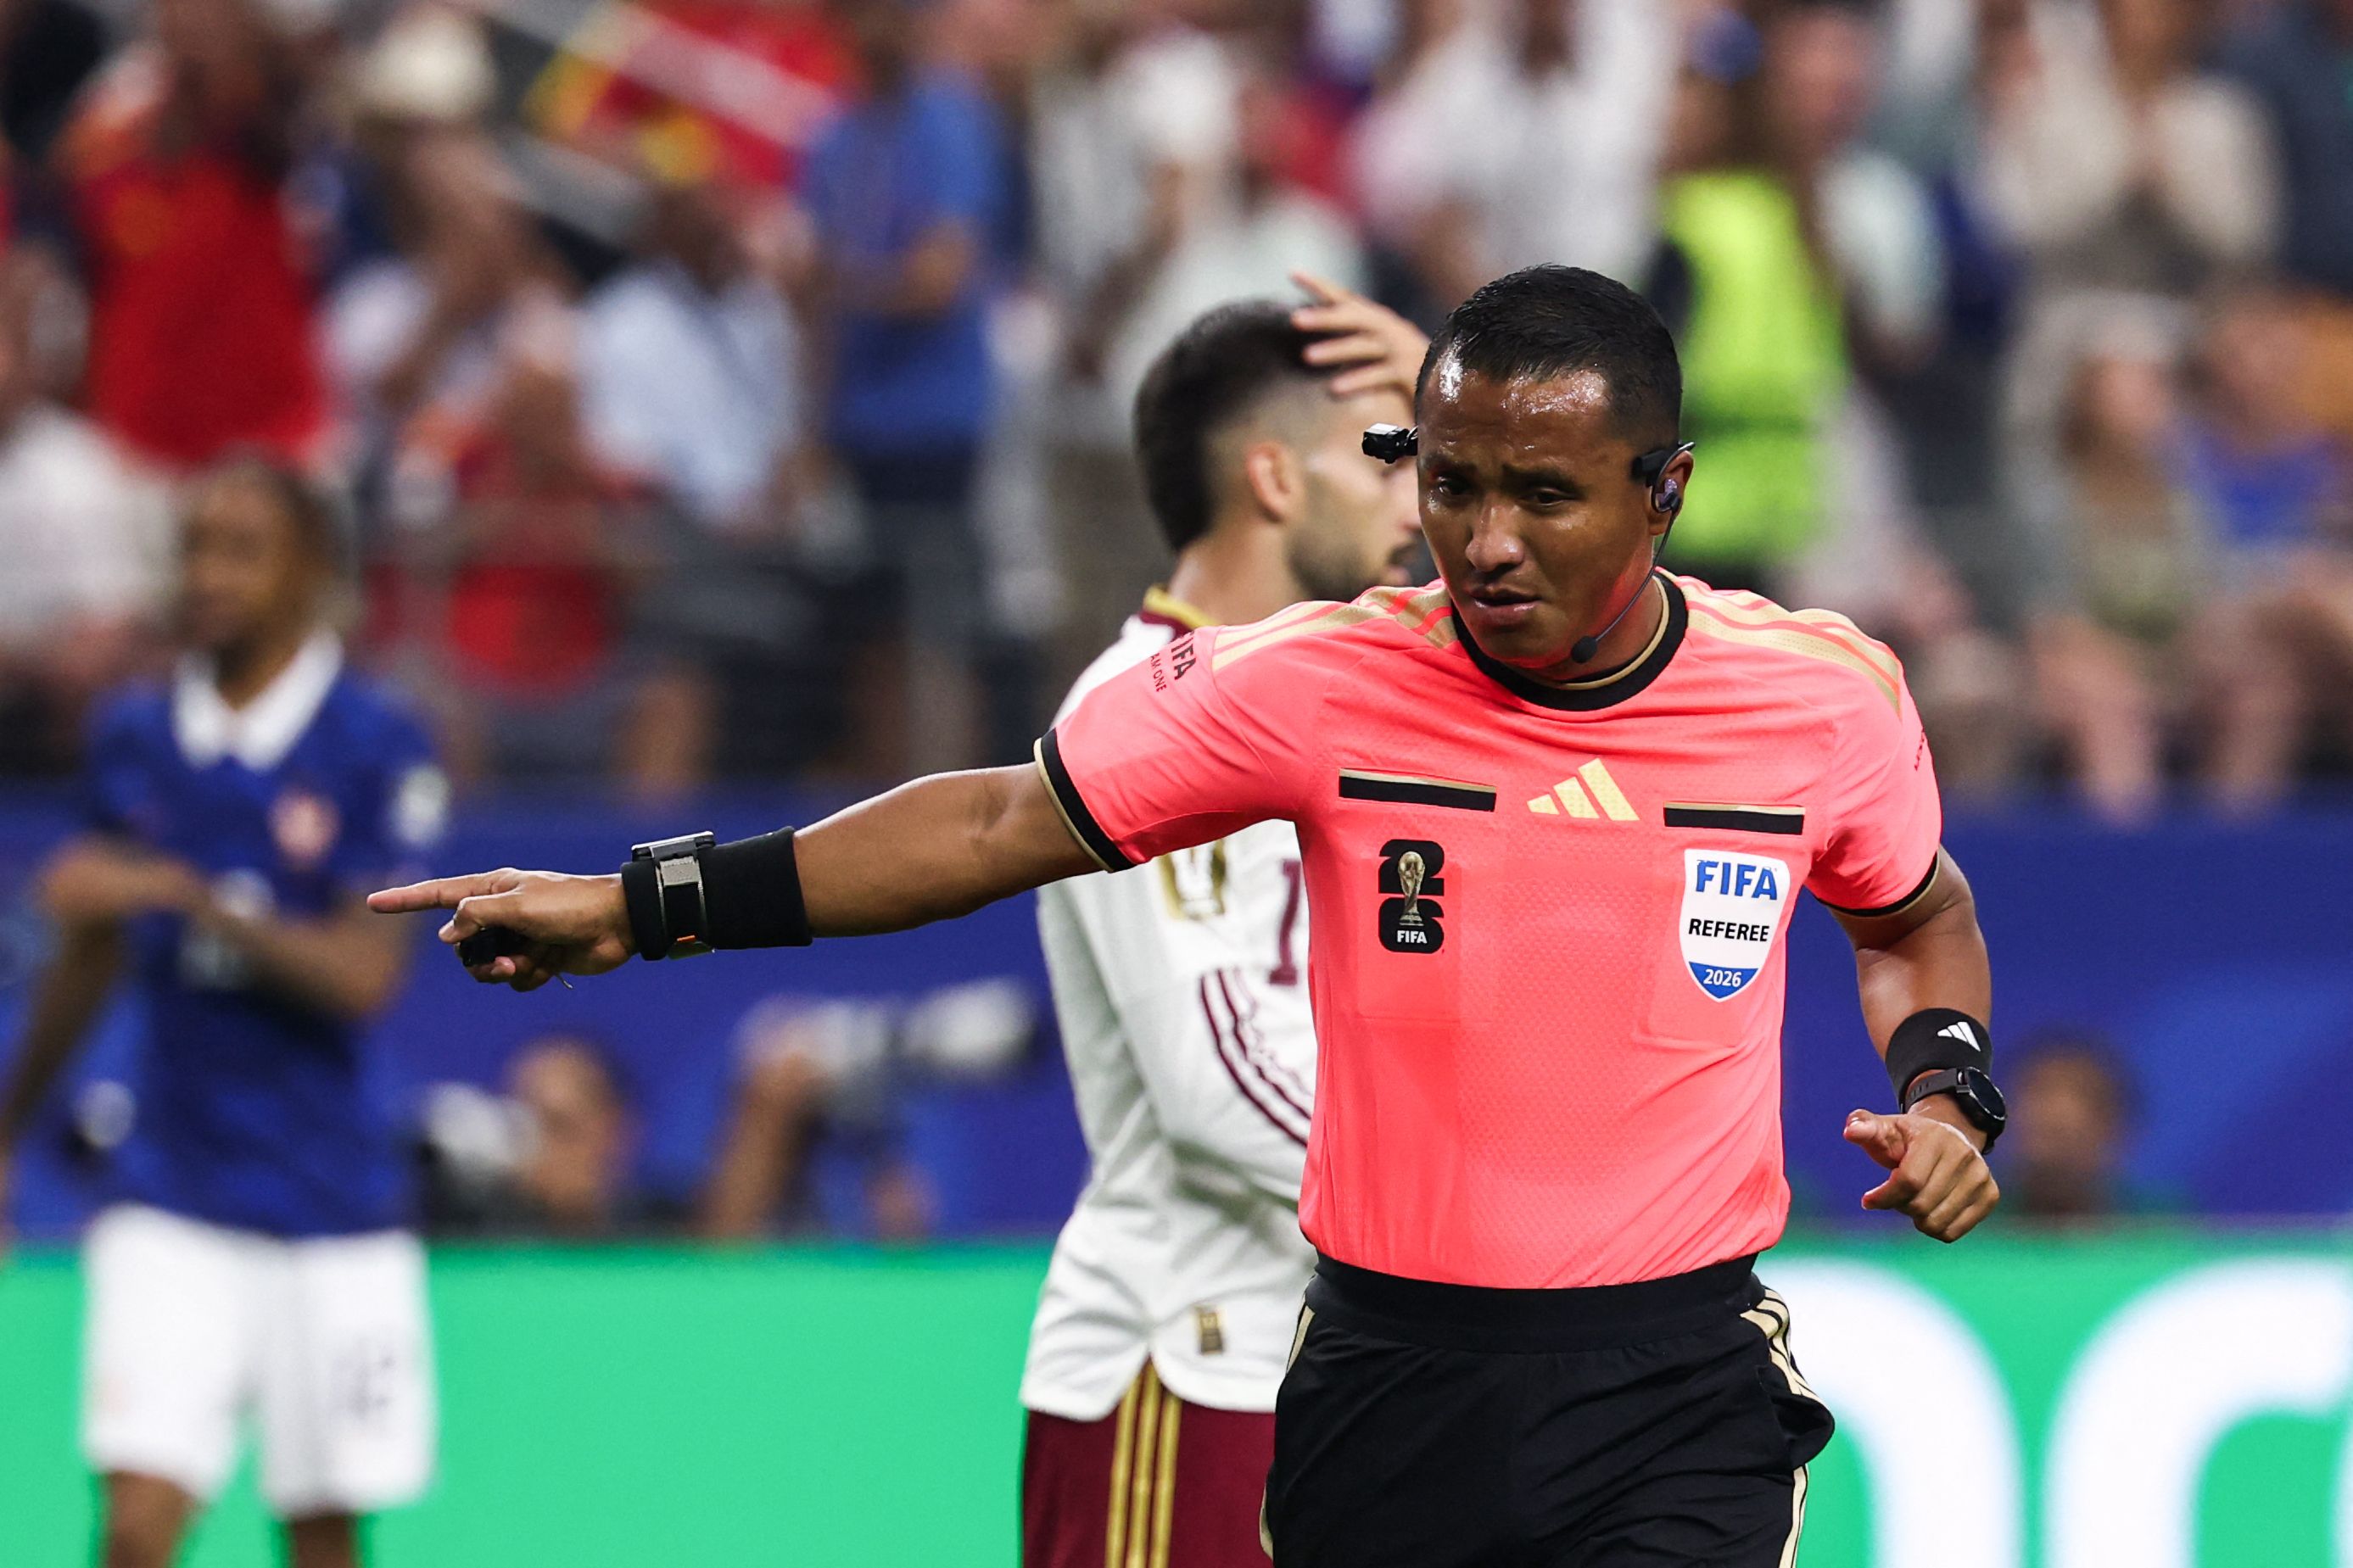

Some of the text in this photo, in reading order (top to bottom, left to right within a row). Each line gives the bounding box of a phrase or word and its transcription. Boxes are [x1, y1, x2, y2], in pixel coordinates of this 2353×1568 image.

[1171, 630, 1197, 680] IFA
[1153, 669, 1167, 692] ONE
[1696, 860, 1778, 900] FIFA
[1396, 929, 1428, 944] FIFA
[1688, 918, 1770, 942] REFEREE
[1702, 968, 1741, 987] 2026
